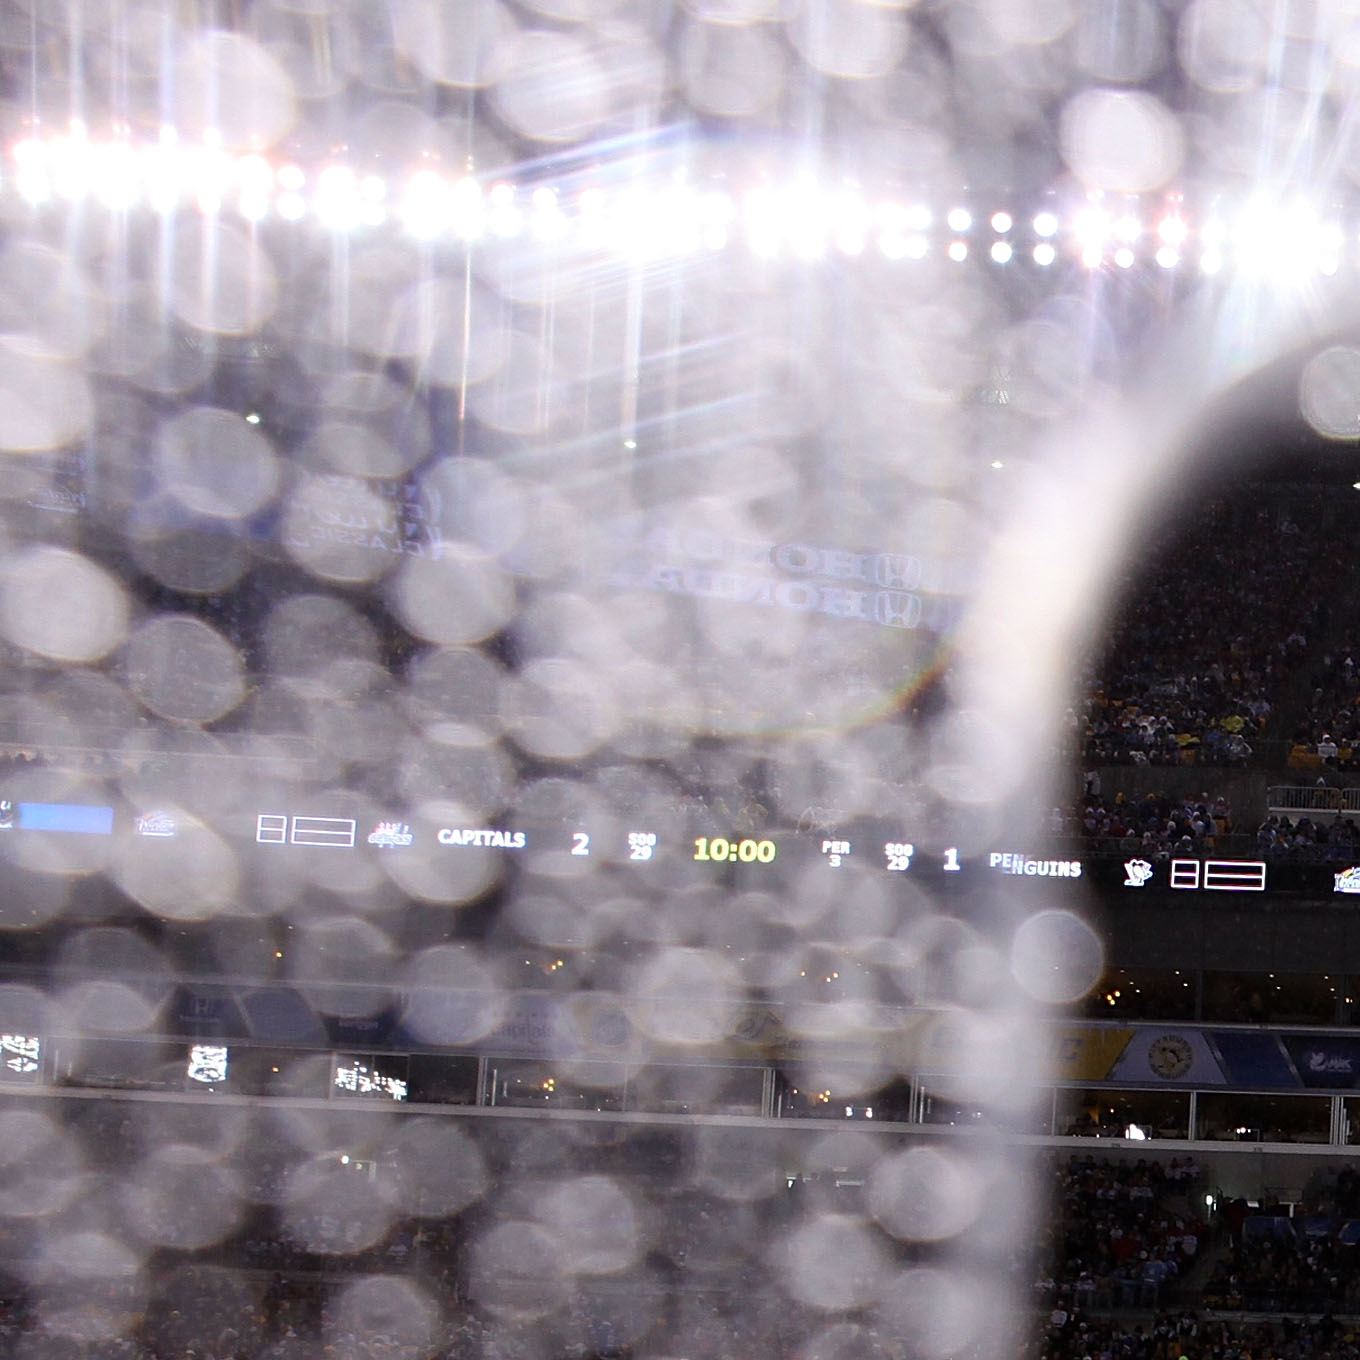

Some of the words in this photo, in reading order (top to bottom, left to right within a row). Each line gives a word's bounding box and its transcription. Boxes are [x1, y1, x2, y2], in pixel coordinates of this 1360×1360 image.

[438, 828, 526, 849] CAPITALS
[571, 832, 590, 856] 2
[822, 841, 851, 855] PER
[629, 845, 653, 860] 29
[693, 838, 776, 863] 10:00
[828, 854, 842, 868] 3
[943, 848, 961, 871] 1
[886, 855, 910, 871] 29
[990, 852, 1082, 878] PENGUINS
